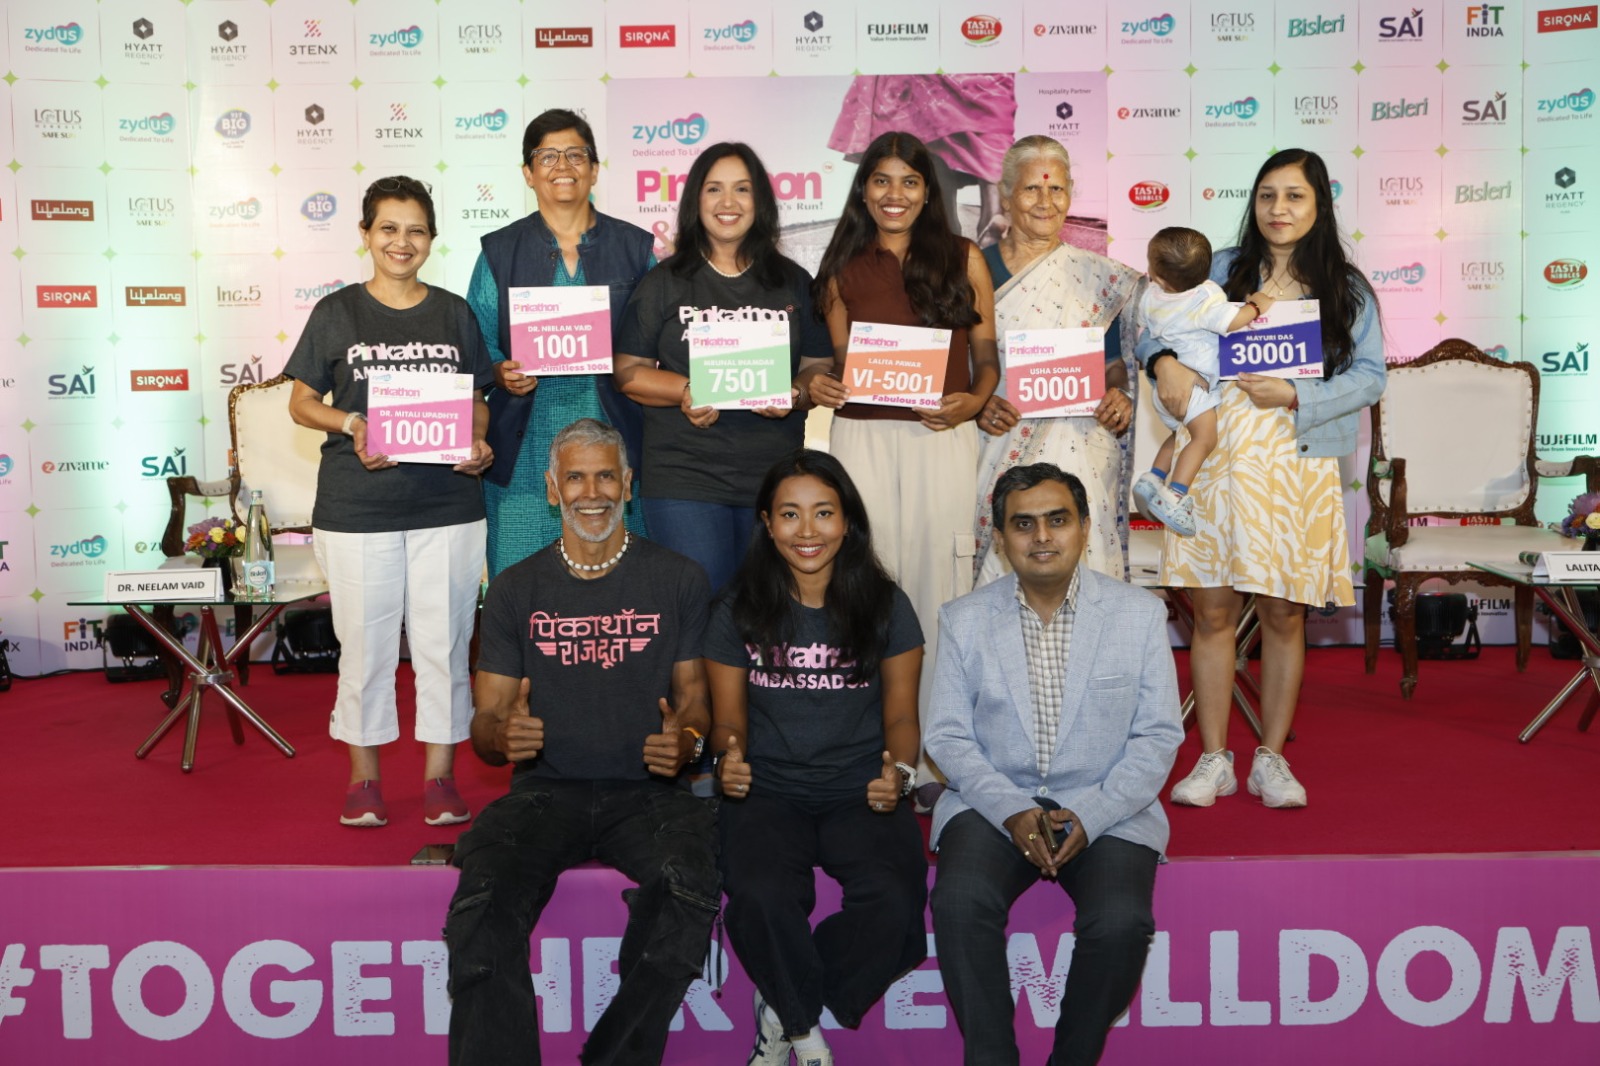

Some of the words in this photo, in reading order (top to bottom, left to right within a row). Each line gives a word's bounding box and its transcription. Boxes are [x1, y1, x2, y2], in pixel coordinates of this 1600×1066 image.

[966, 20, 995, 29] TASTY
[1121, 17, 1170, 36] zydus
[1288, 14, 1345, 38] Bisleri
[1378, 16, 1423, 38] SAI
[1543, 14, 1591, 27] SIRONA
[24, 23, 78, 43] zydus
[369, 28, 418, 48] zydus
[625, 31, 670, 43] SIRONA
[704, 23, 752, 43] zydus
[795, 36, 831, 45] HYATT
[1466, 27, 1504, 37] INDIA
[124, 42, 163, 52] HYATT
[210, 45, 247, 54] HYATT
[289, 44, 338, 55] 3TENX
[1038, 88, 1069, 96] Hospitality
[1205, 101, 1253, 119] zydus
[1371, 98, 1429, 121] Bisleri
[1462, 100, 1507, 122] SAI
[1538, 94, 1589, 113] zydus
[119, 114, 169, 135] zydus
[222, 118, 247, 130] BIG
[455, 111, 503, 132] zydus
[297, 128, 333, 137] HYATT
[375, 128, 423, 139] 3TENX
[632, 121, 700, 144] zydus
[632, 148, 676, 157] Dedicated
[678, 148, 688, 156] To
[689, 148, 701, 156] Lif
[637, 166, 822, 202] Pinon
[1454, 181, 1512, 204] Bisleri
[1545, 192, 1585, 201] HYATT
[209, 200, 256, 219] zydus
[307, 201, 333, 212] BIG
[462, 208, 510, 219] 3TENX
[797, 202, 824, 210] Run!
[1372, 264, 1419, 284] zydus
[1550, 264, 1581, 273] TASTY
[42, 291, 91, 304] SIRONA
[217, 285, 262, 302] Inc.5
[679, 305, 788, 324] Pinkathon
[347, 342, 460, 364] Pinkathon
[533, 334, 588, 359] 1001
[1231, 342, 1307, 365] 30001
[541, 364, 584, 372] Limitless
[868, 358, 893, 366] LALITA
[1542, 351, 1589, 373] SAI
[136, 375, 183, 388] SIRONA
[220, 364, 264, 384] SAI
[708, 368, 768, 393] 7501
[852, 368, 933, 394] VI-5001
[48, 374, 96, 395] SAI
[1018, 376, 1090, 402] 50001
[740, 398, 768, 406] Super
[771, 398, 788, 406] 75k
[872, 395, 916, 404] Fabulous
[395, 410, 420, 418] MITALI
[422, 412, 459, 420] UPADHYE
[381, 420, 456, 447] 10001
[141, 456, 187, 477] SAI
[51, 540, 102, 558] zydus
[117, 583, 135, 592] DR.
[138, 582, 179, 592] NEELAM
[181, 581, 205, 590] VAID
[530, 608, 660, 639] पिंकाथॉन
